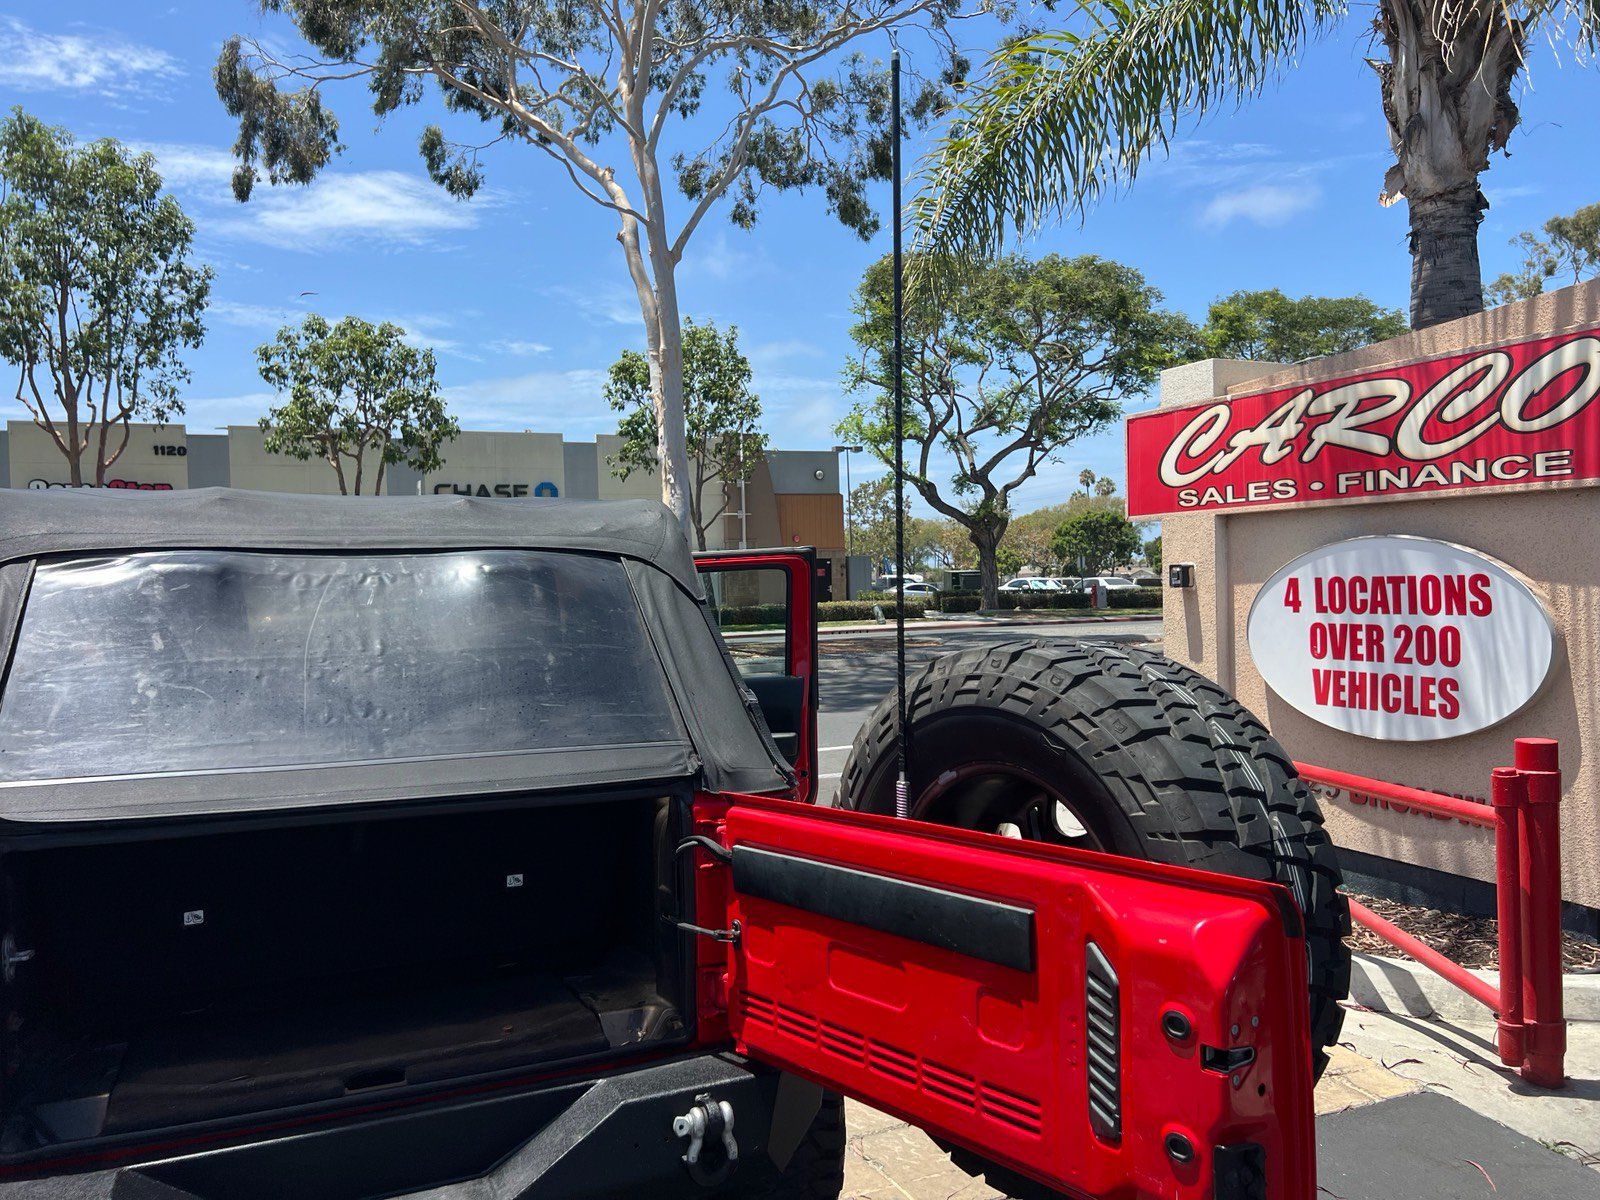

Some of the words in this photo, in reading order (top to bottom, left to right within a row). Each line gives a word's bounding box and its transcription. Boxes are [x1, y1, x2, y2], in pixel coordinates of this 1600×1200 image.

[1158, 335, 1600, 488] CARCO
[153, 445, 187, 457] 1120
[434, 484, 529, 498] CHASE
[1177, 478, 1298, 508] SALES
[1337, 449, 1574, 496] FINANCE
[1284, 577, 1302, 613] 4
[1314, 573, 1493, 617] LOCATIONS
[1309, 622, 1385, 663] OVER
[1393, 624, 1462, 668] 200
[1312, 668, 1460, 720] VEHICLES
